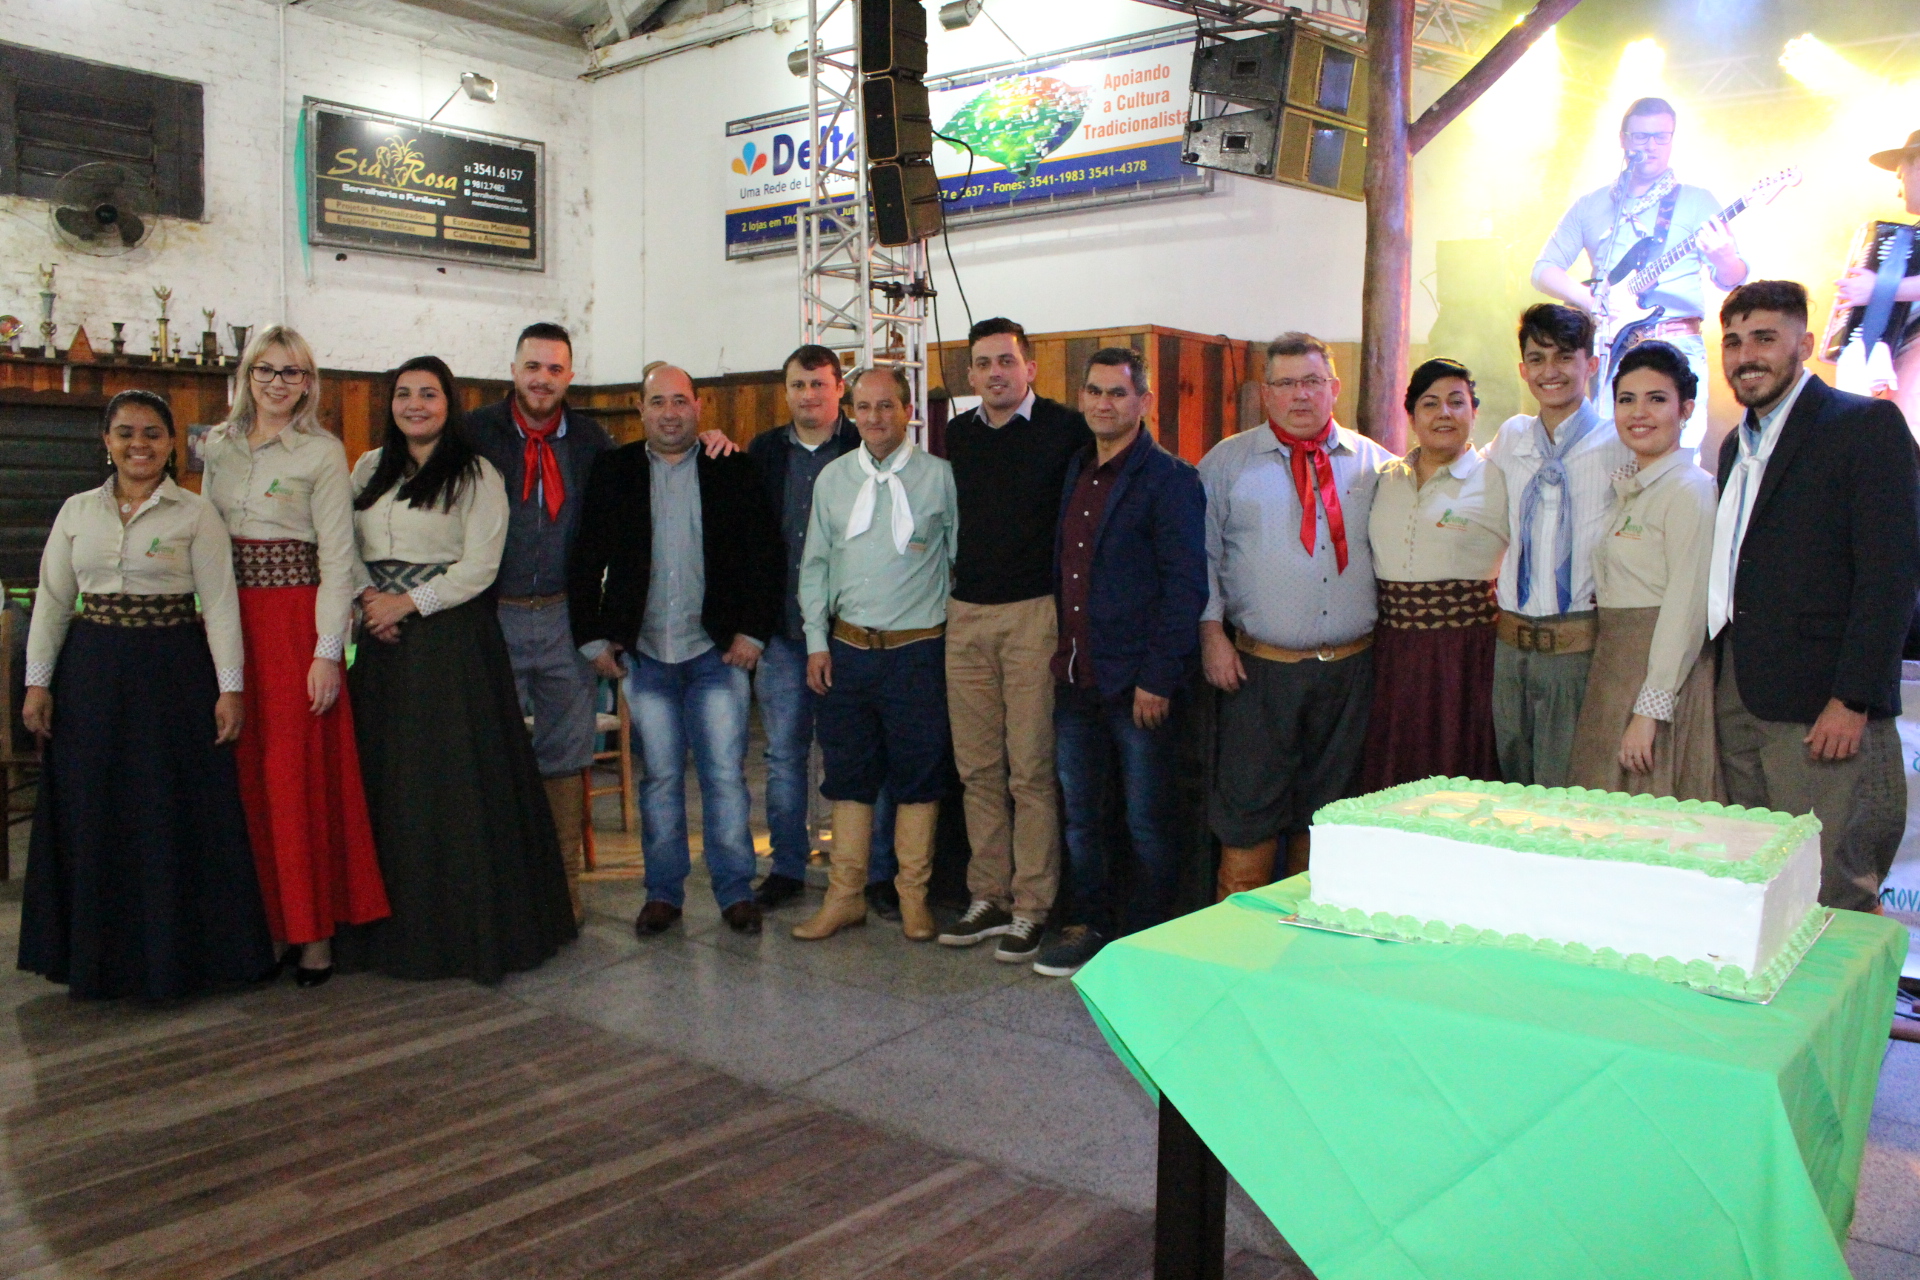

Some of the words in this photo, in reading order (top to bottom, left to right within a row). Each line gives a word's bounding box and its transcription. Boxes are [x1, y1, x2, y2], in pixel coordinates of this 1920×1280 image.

[1103, 64, 1170, 91] Apoiando
[1103, 101, 1111, 113] a
[1117, 90, 1170, 111] Cultura
[1083, 109, 1190, 140] Tradicionalista
[394, 155, 458, 191] Rosa
[472, 162, 523, 181] 3541.6157
[950, 191, 957, 200] e
[994, 180, 1026, 193] Fones:
[1029, 170, 1085, 188] 3541-1983
[1088, 160, 1147, 179] 3541-4378
[342, 183, 397, 199] Serralheria
[740, 187, 761, 199] Uma
[764, 181, 787, 195] Rede
[790, 178, 802, 191] de
[336, 200, 369, 213] Projetos
[371, 206, 426, 221] Personalizados
[741, 222, 747, 232] 2
[749, 220, 767, 232] lojas
[769, 218, 782, 228] em
[1882, 886, 1920, 912] NOV
